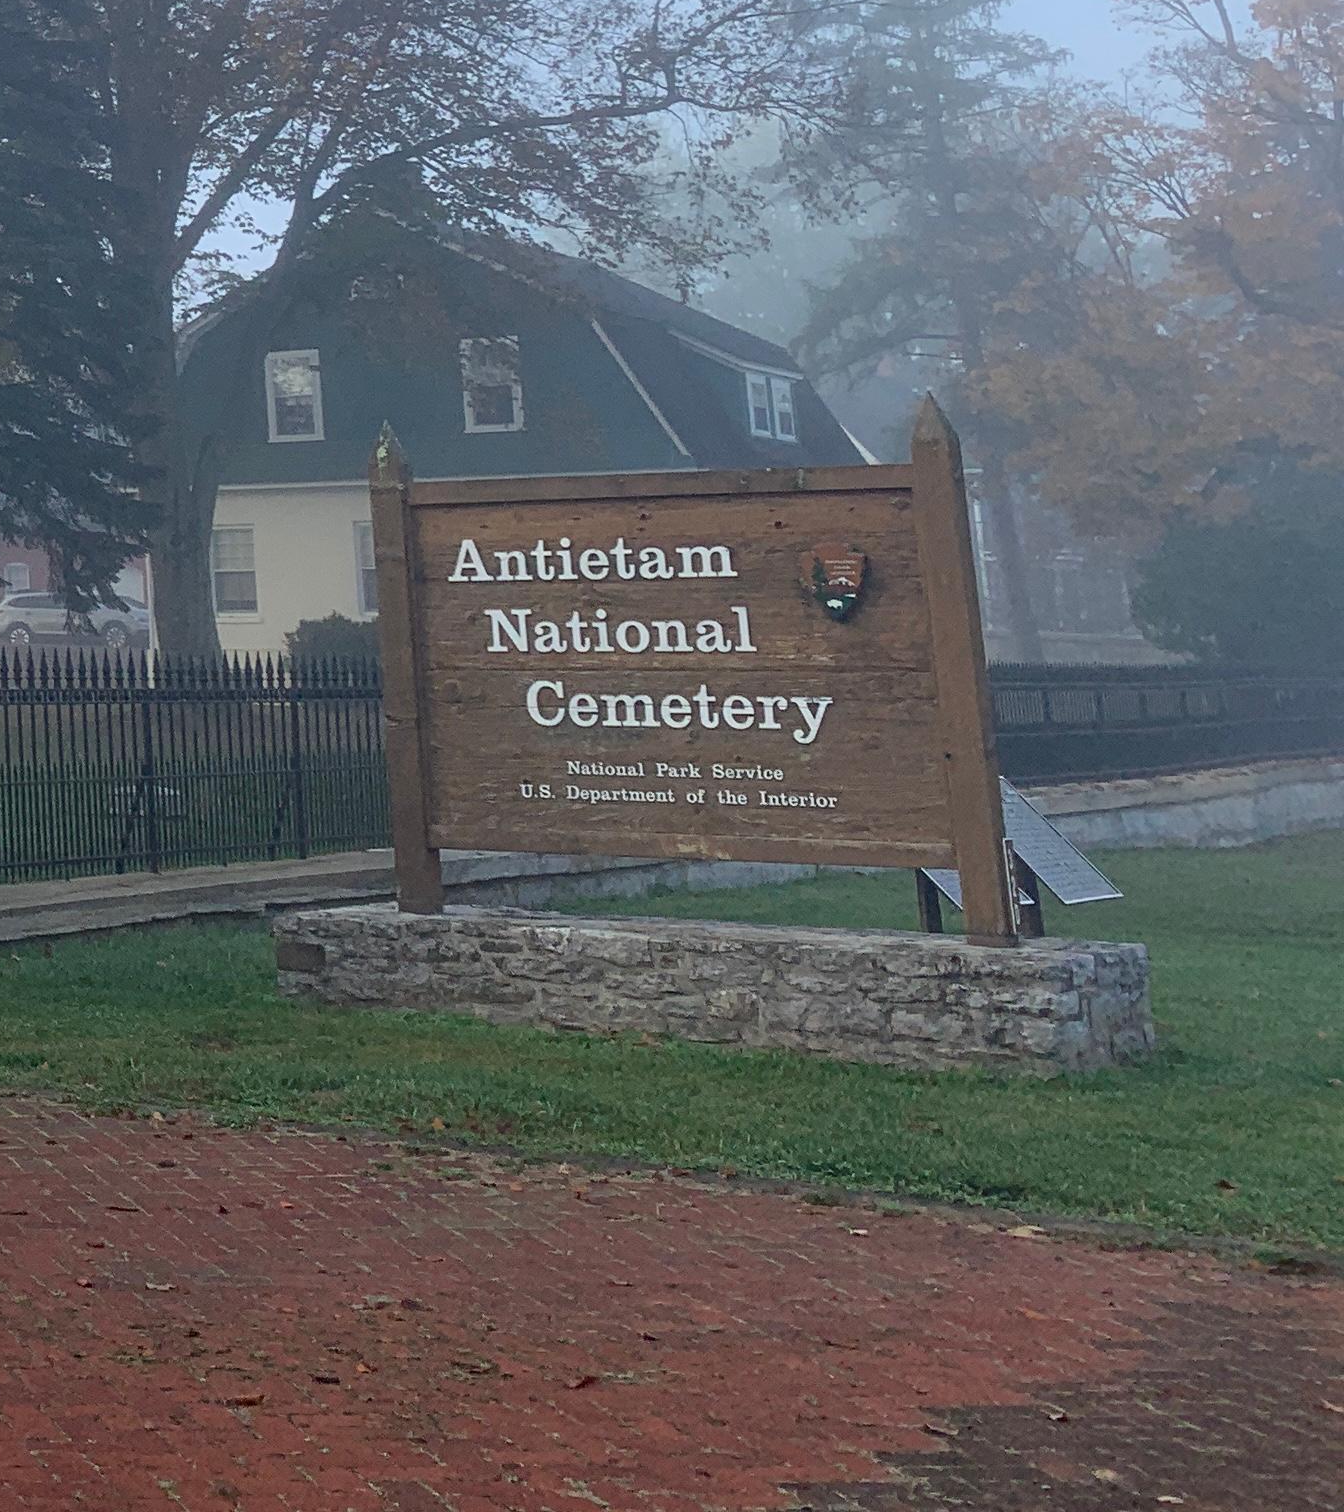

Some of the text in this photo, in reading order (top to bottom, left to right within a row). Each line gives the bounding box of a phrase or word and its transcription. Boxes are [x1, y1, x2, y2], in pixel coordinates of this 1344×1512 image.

[448, 537, 738, 582] Antietam
[484, 606, 758, 653] National
[526, 680, 833, 744] Cemetery
[566, 760, 784, 781] National Park Service
[519, 783, 838, 808] U.S. Department of the Interior
